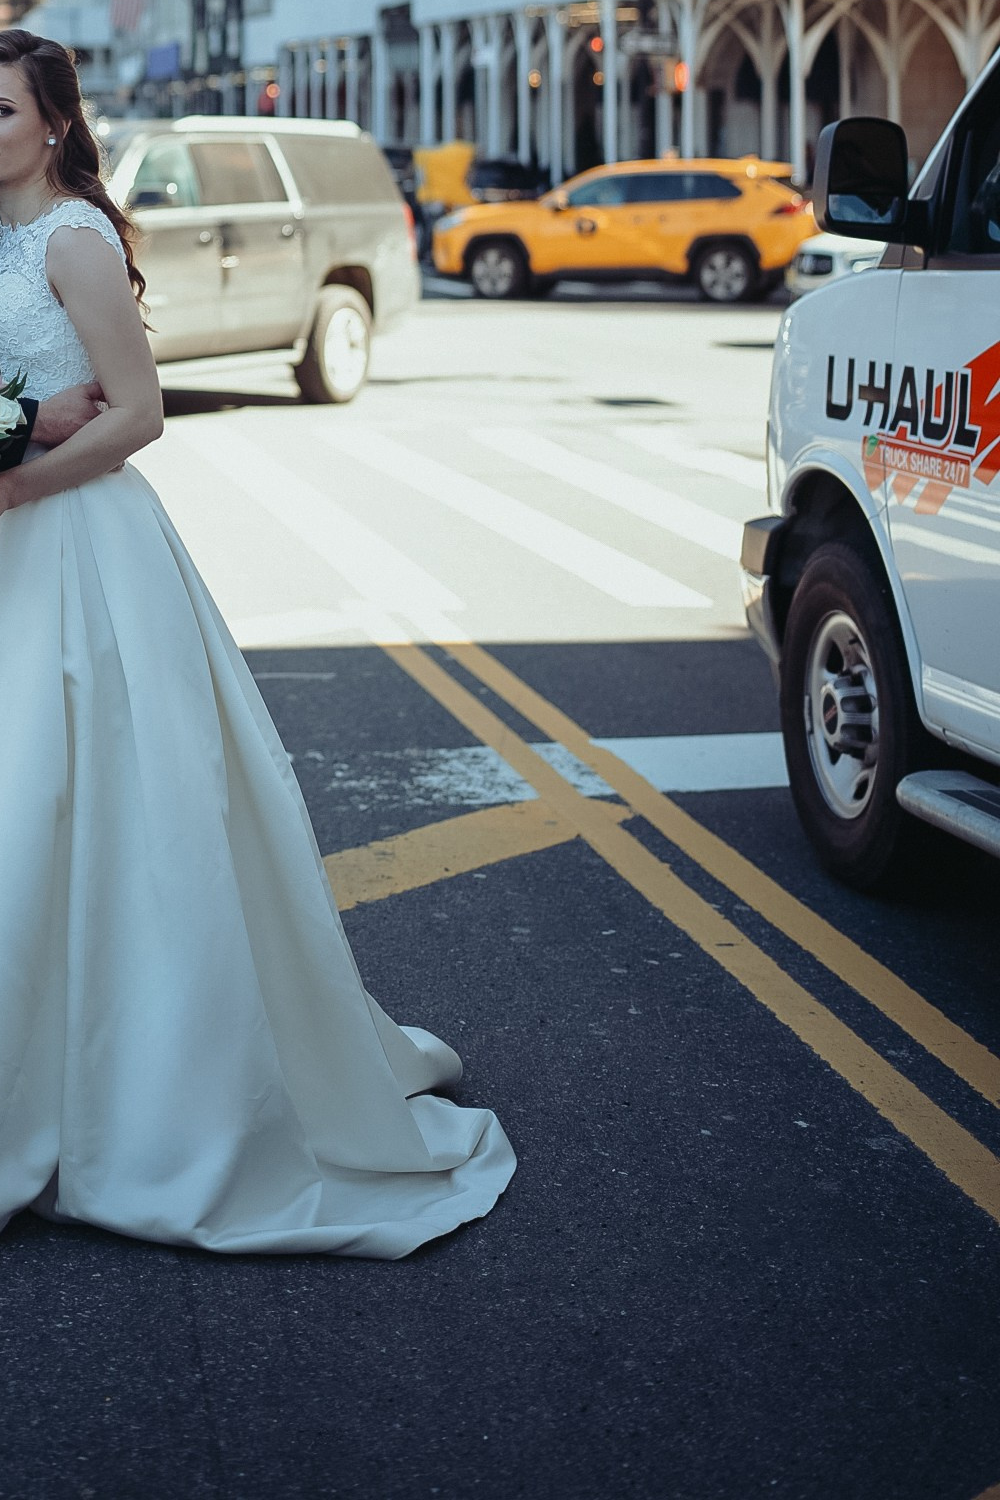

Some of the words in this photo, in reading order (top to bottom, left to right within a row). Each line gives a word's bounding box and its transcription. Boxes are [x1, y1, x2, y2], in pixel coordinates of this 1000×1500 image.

[879, 444, 909, 470] TRUCK
[910, 452, 942, 477] SHARE
[943, 460, 967, 485] 24/7
